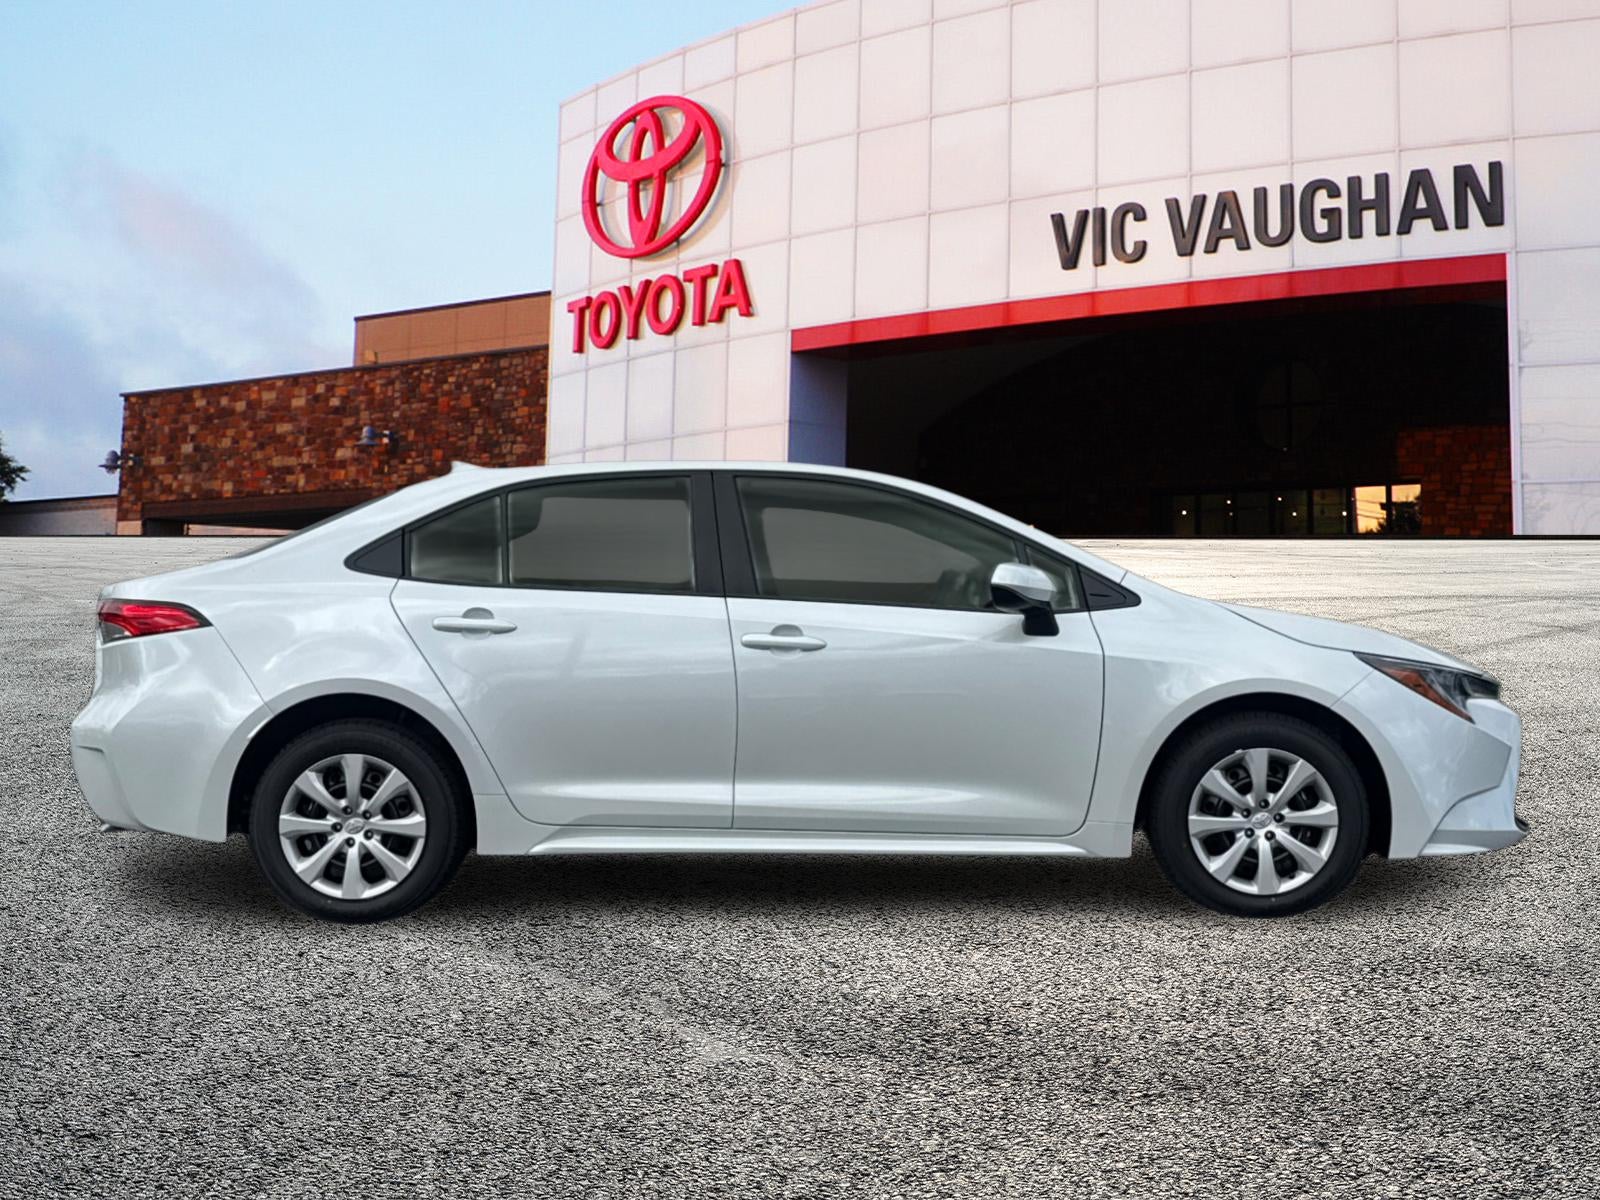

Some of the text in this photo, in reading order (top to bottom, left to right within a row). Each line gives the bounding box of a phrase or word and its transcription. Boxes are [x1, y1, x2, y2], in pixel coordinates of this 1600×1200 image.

[1050, 160, 1505, 271] VIC VAUGHAN
[567, 258, 754, 354] TOYOTA
